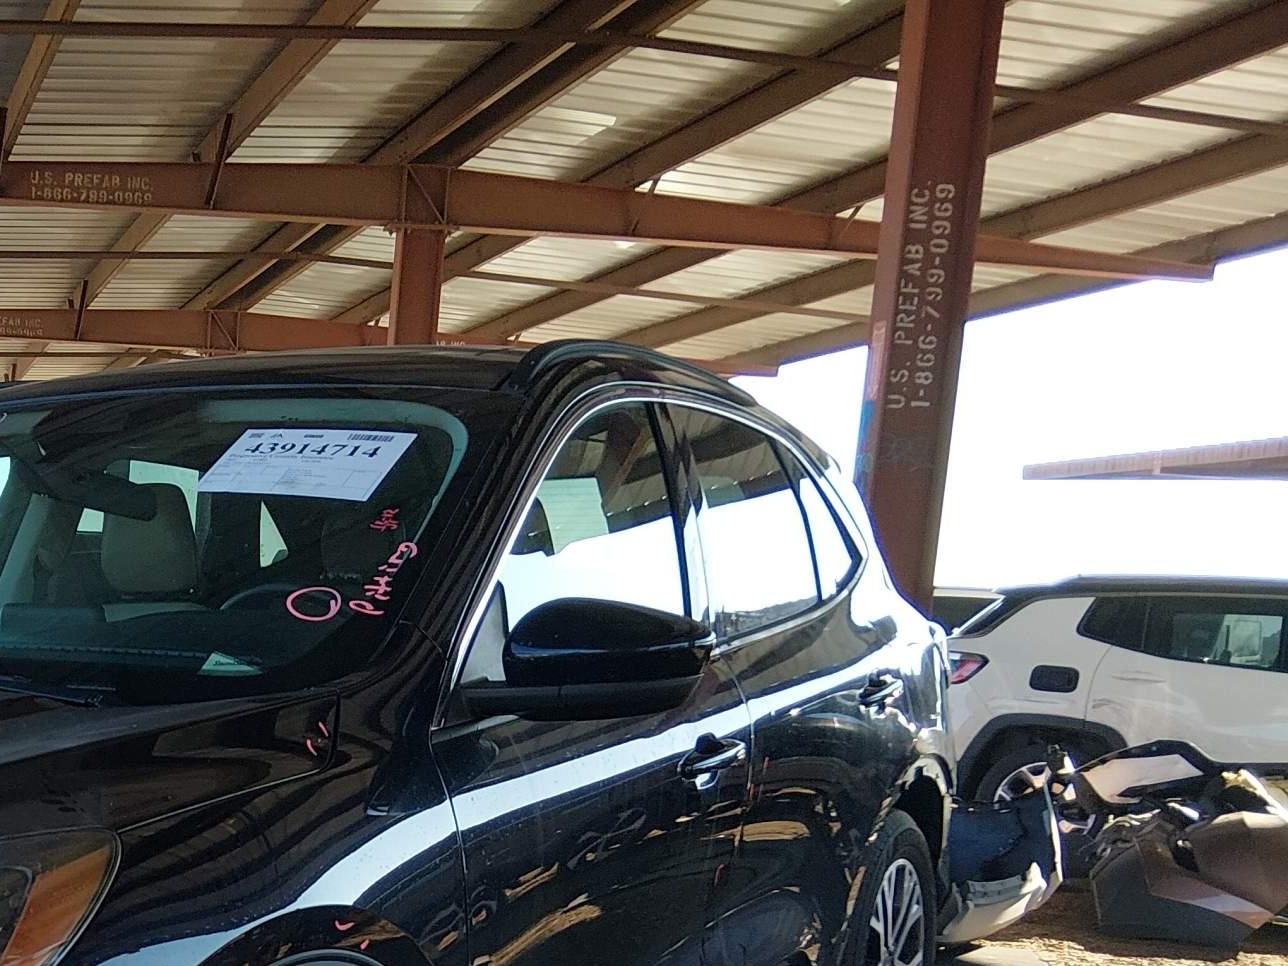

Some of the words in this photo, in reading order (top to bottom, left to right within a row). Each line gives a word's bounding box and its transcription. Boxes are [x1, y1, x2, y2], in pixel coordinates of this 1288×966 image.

[31, 170, 58, 185] U.S.
[65, 172, 120, 188] PREFAB
[127, 176, 153, 191] INC.
[894, 243, 924, 345] PREFAB
[910, 183, 956, 407] 1-866-799-0969
[887, 361, 911, 409] U.S.
[244, 442, 382, 458] 43914714
